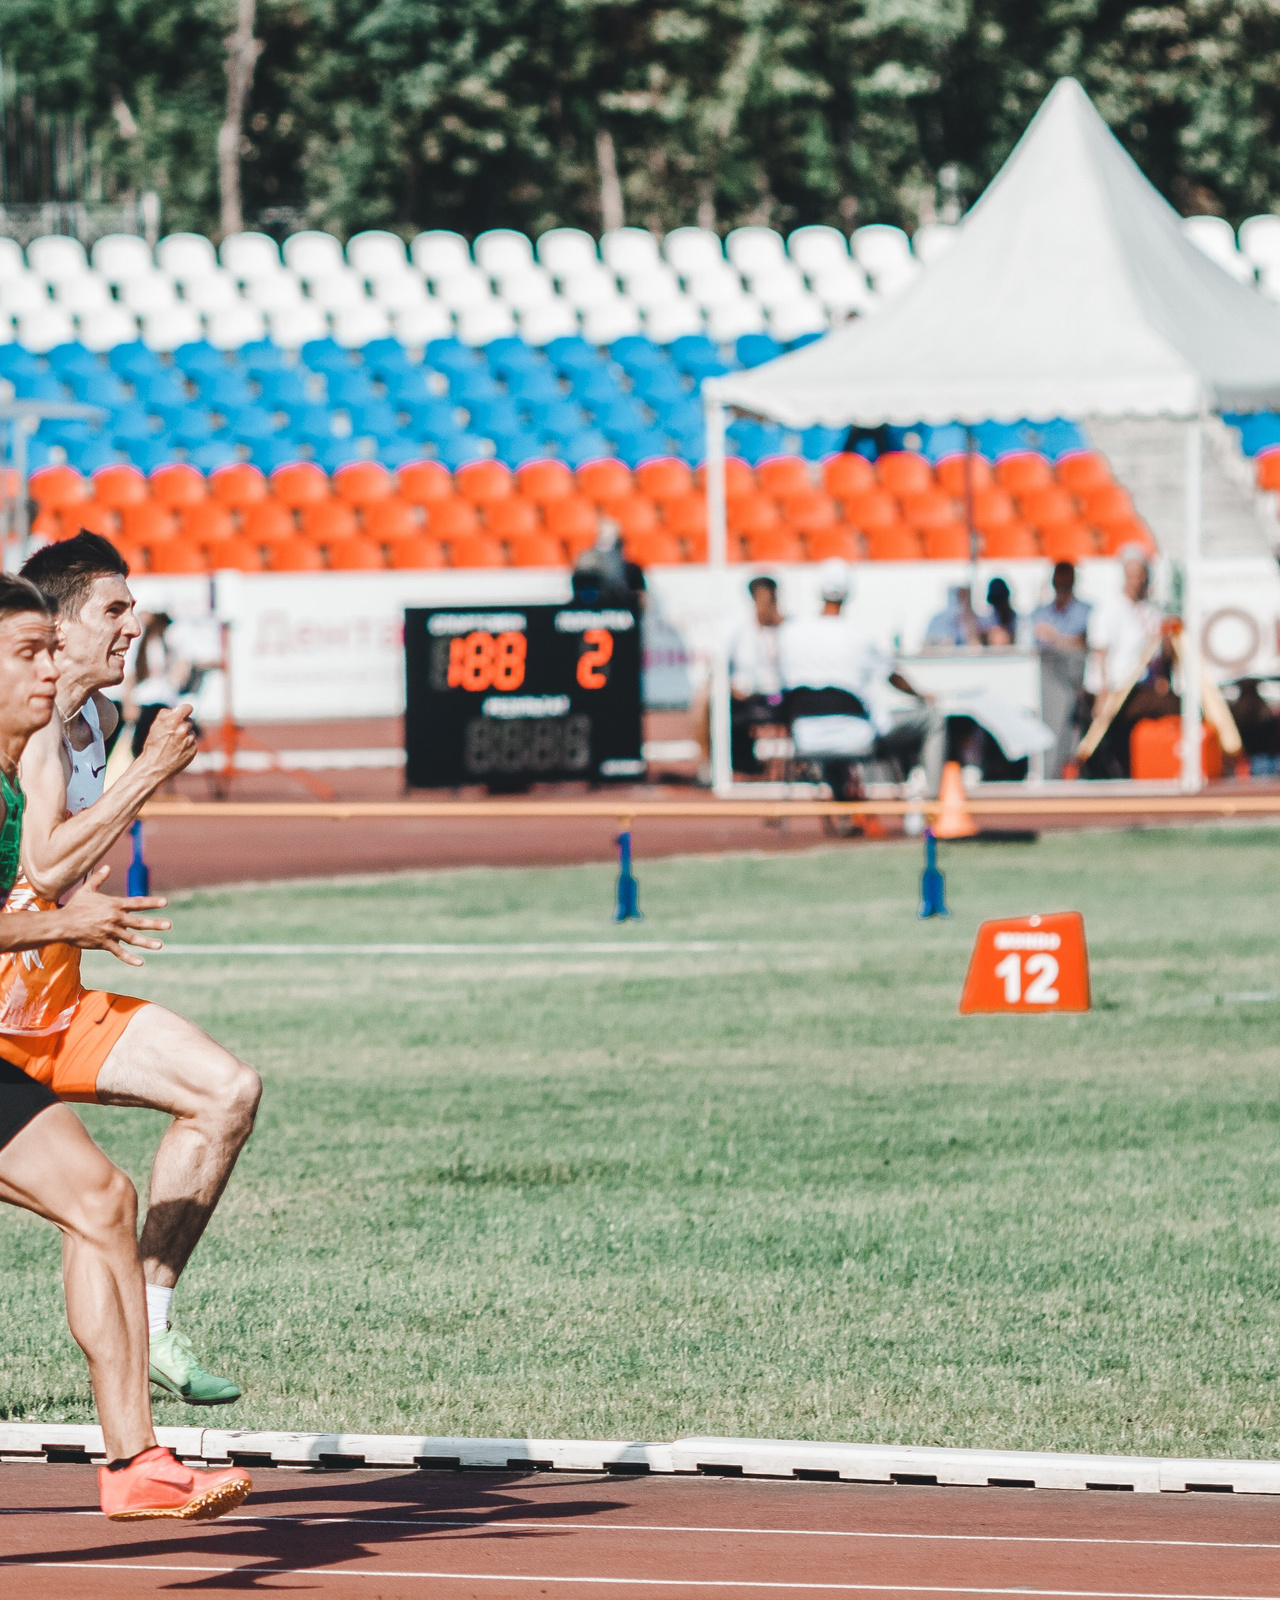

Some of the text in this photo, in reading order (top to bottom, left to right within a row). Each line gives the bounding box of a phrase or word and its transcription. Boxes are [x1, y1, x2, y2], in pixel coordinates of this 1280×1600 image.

[447, 631, 527, 692] 188
[576, 628, 614, 690] 2
[994, 952, 1060, 1004] 12
